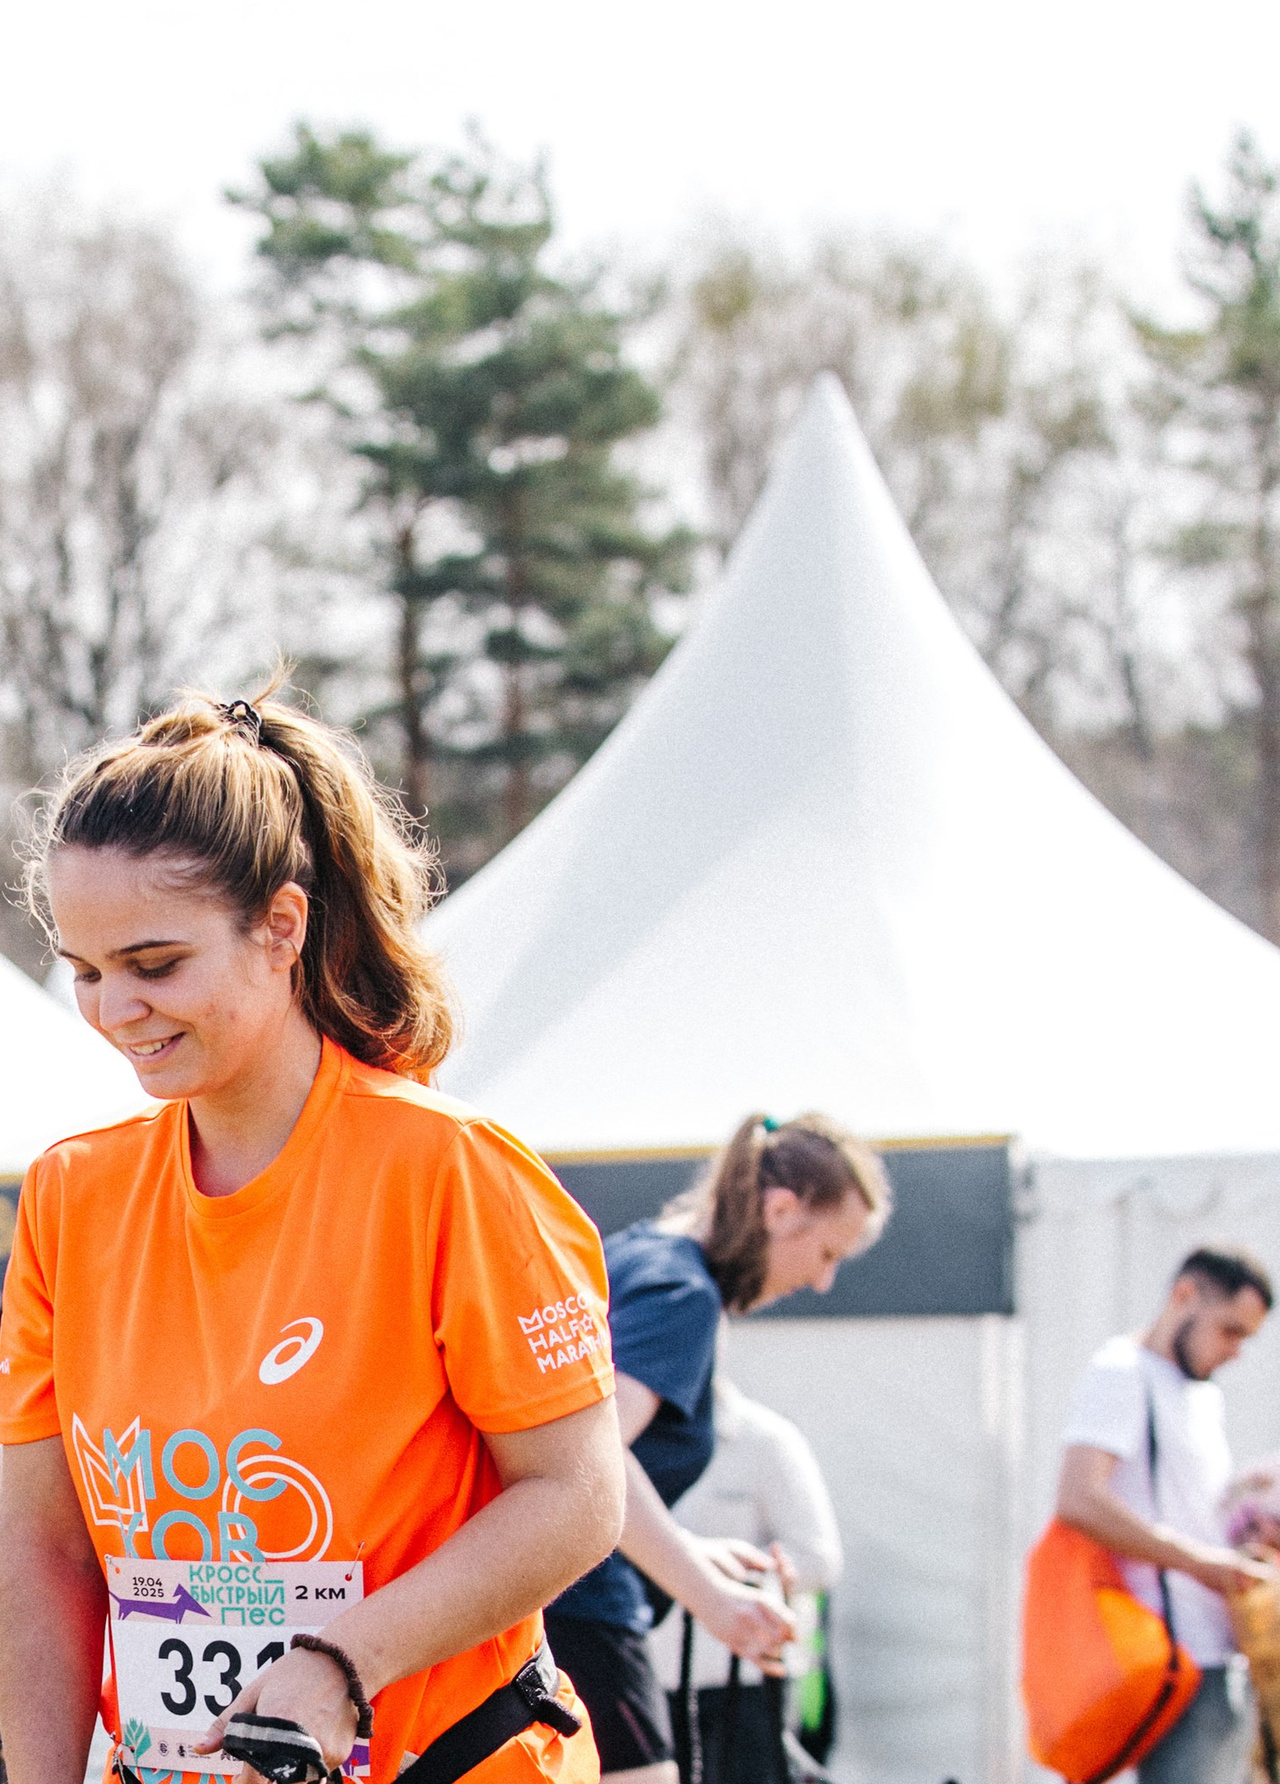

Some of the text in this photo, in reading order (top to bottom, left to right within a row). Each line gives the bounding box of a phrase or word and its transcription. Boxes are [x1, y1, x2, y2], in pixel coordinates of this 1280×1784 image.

[517, 1292, 590, 1335] MOSCO
[527, 1318, 580, 1355] HALF
[103, 1428, 288, 1502] МОС
[132, 1576, 163, 1587] 19.04
[133, 1586, 165, 1598] 2025
[295, 1585, 308, 1600] 2
[158, 1638, 285, 1717] 33
